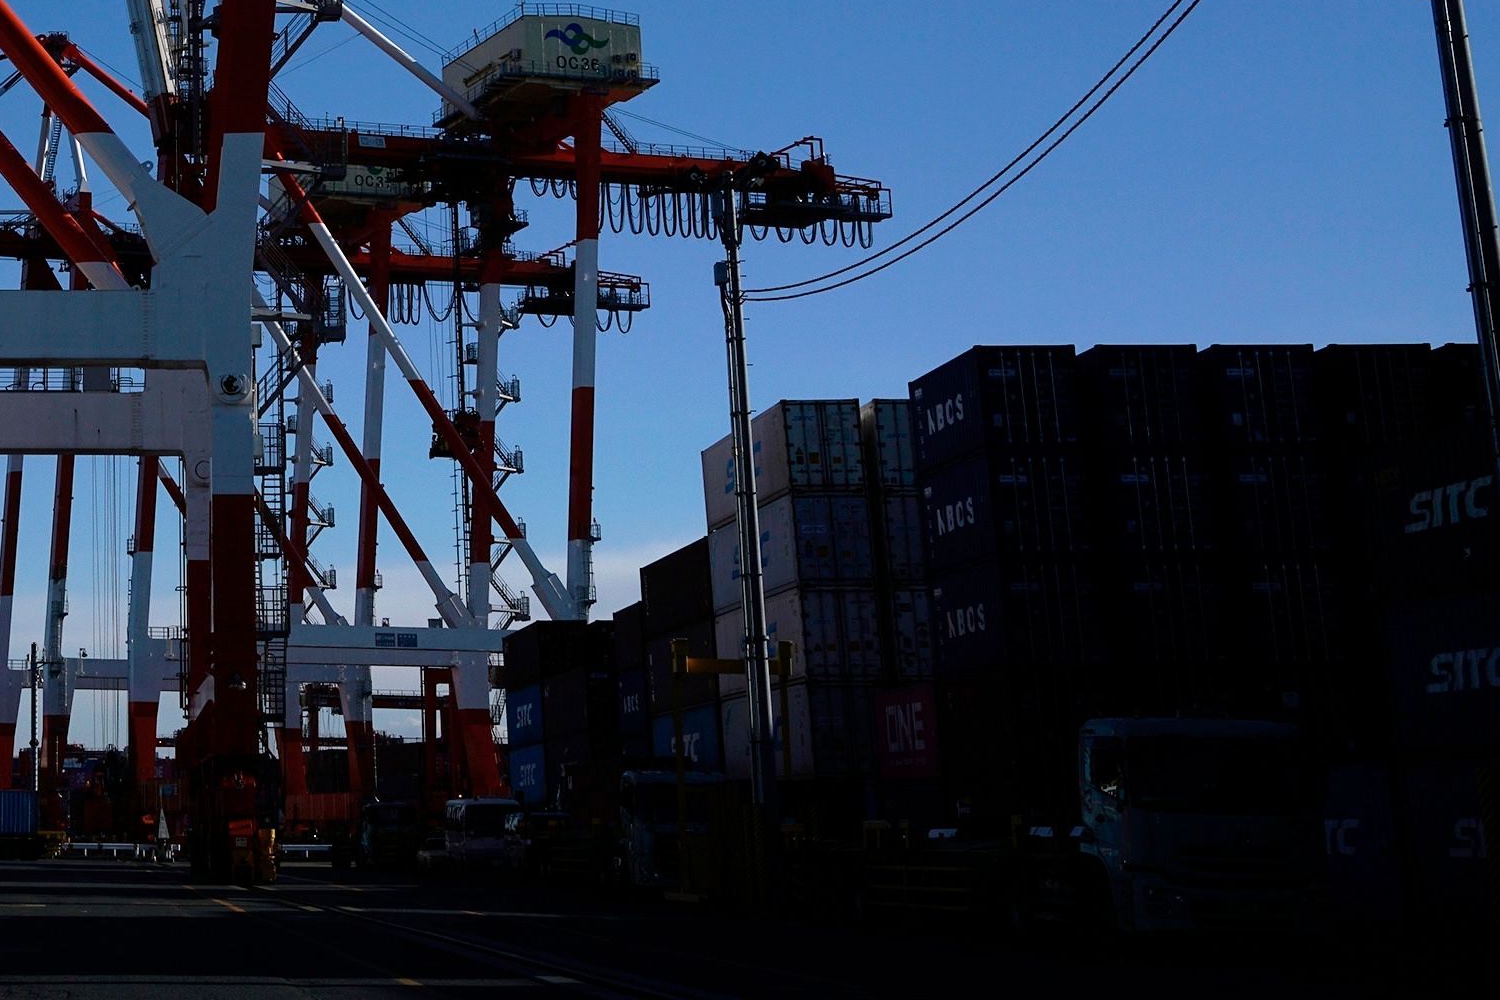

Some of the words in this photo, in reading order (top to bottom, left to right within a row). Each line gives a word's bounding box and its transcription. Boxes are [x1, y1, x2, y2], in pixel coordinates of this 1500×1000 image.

[556, 55, 600, 72] OC36
[355, 174, 392, 189] OC3
[1404, 474, 1493, 535] SITC
[885, 701, 927, 753] ONE
